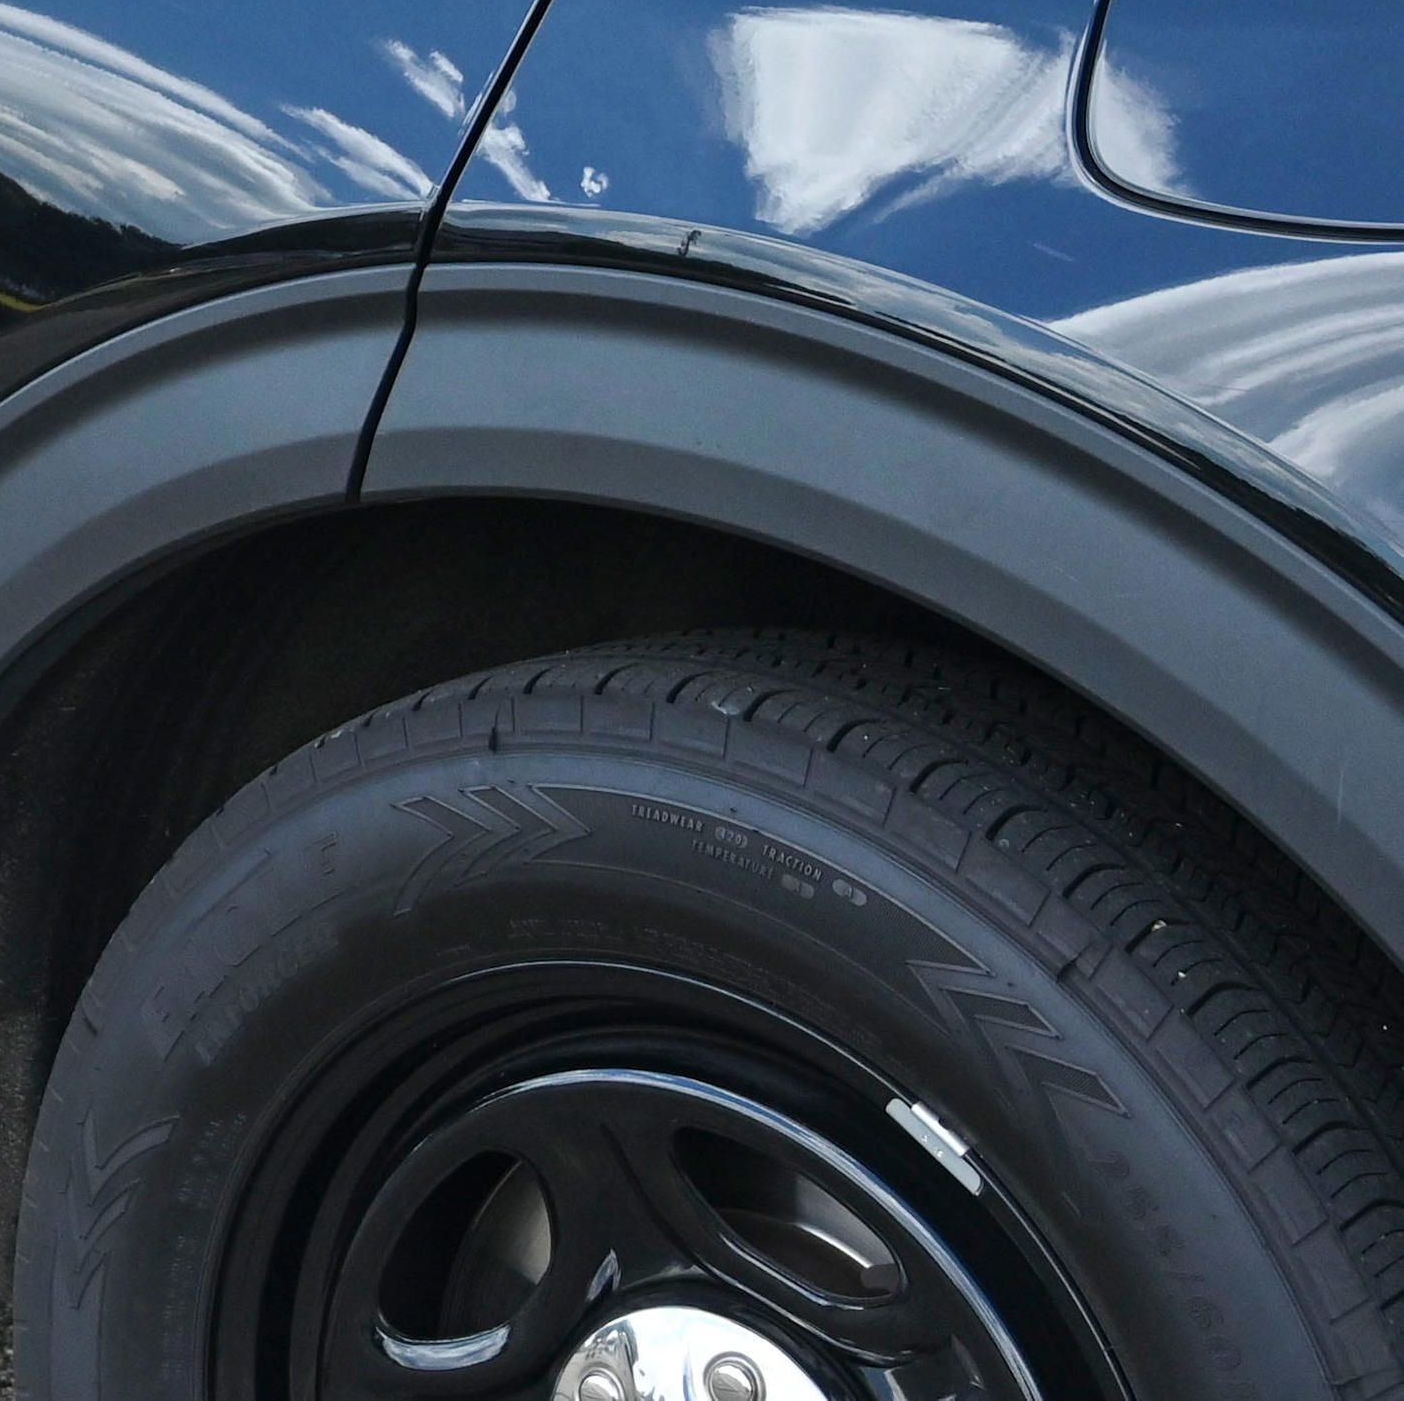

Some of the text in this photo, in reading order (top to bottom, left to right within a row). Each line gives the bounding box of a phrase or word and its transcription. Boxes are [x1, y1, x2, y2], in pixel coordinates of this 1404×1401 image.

[630, 802, 705, 833] TREADWEAR
[761, 844, 824, 882] TRACTION
[690, 838, 775, 880] TEMPERATURE
